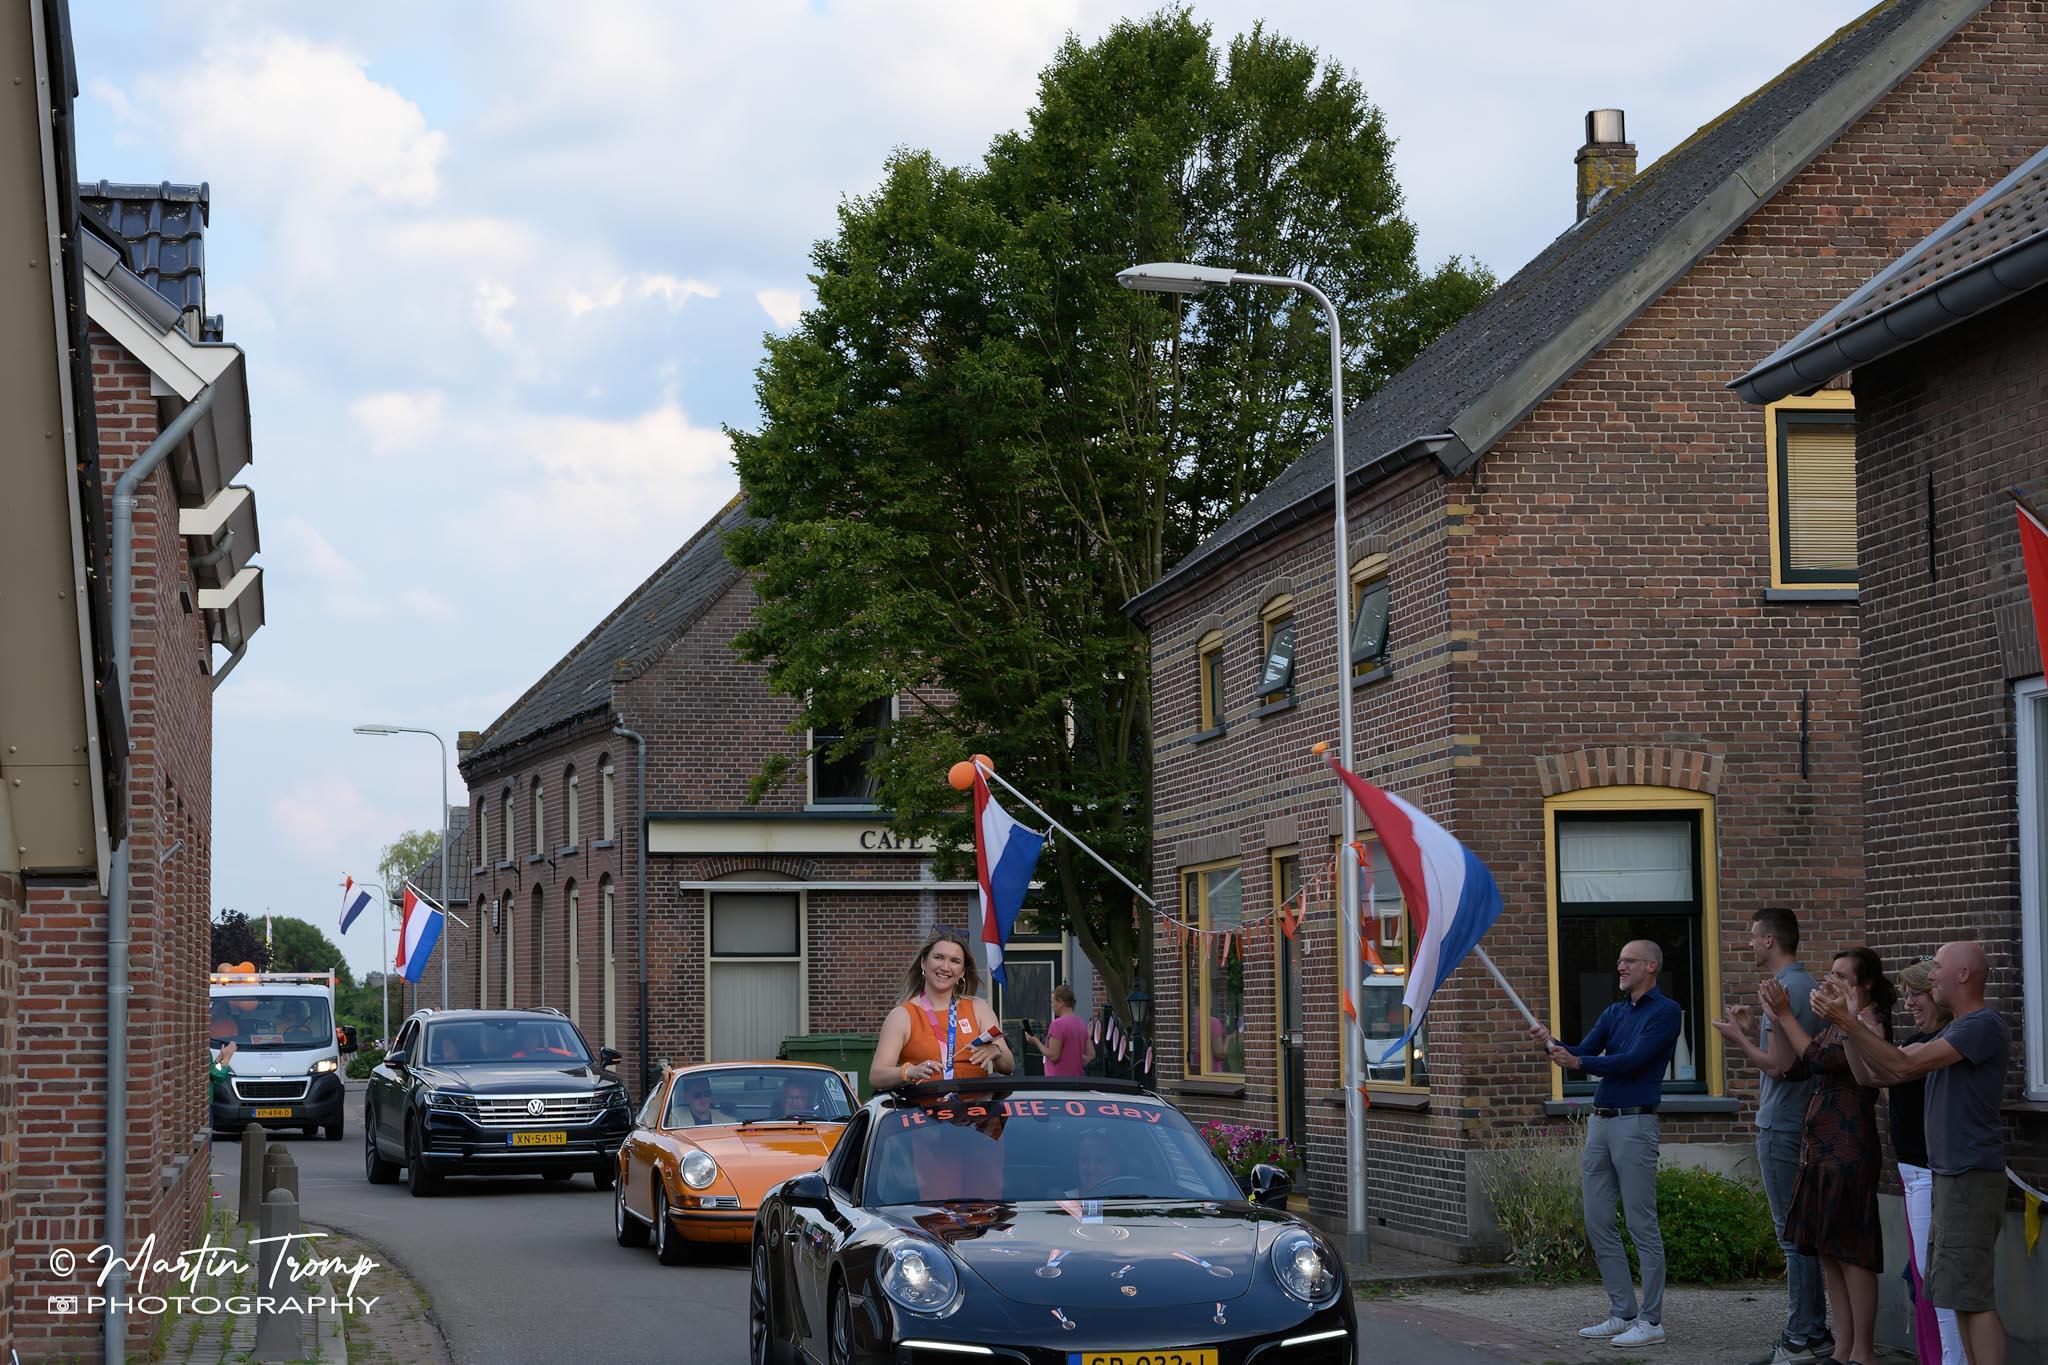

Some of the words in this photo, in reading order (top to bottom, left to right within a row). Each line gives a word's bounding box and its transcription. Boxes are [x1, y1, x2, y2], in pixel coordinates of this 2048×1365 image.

[901, 1109, 954, 1128] it's
[967, 1104, 988, 1117] a
[1000, 1101, 1086, 1117] JEE-O
[1098, 1103, 1163, 1123] day
[517, 1134, 563, 1144] XN-541-H
